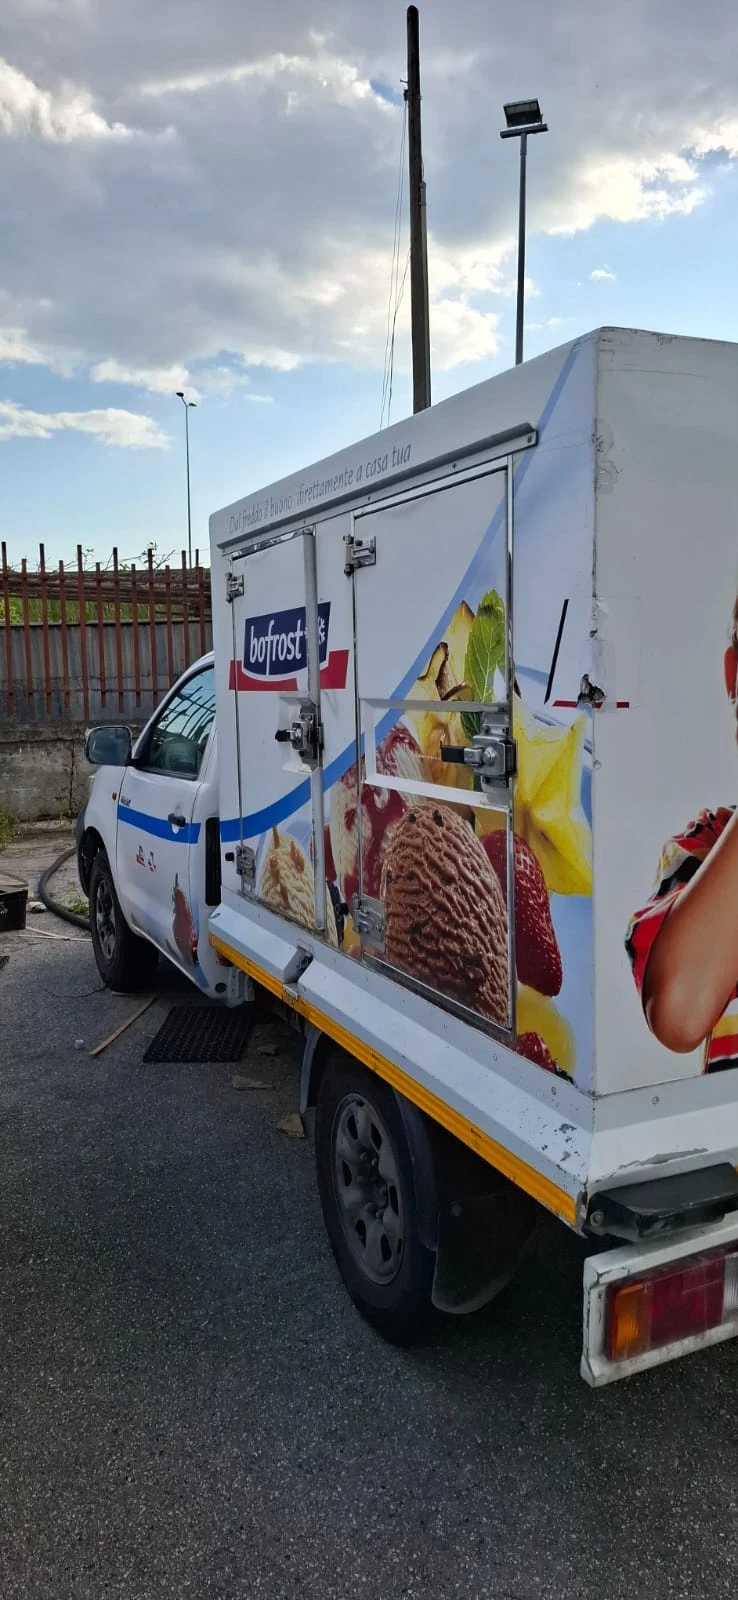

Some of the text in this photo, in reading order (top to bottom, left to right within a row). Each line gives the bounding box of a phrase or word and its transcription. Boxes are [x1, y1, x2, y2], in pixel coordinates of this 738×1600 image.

[242, 503, 263, 533] freddo
[270, 495, 293, 517] buono
[297, 467, 354, 505] direttamente
[356, 464, 363, 482] a
[365, 453, 389, 479] casa
[392, 444, 412, 468] tua
[249, 619, 302, 676] bofrost
